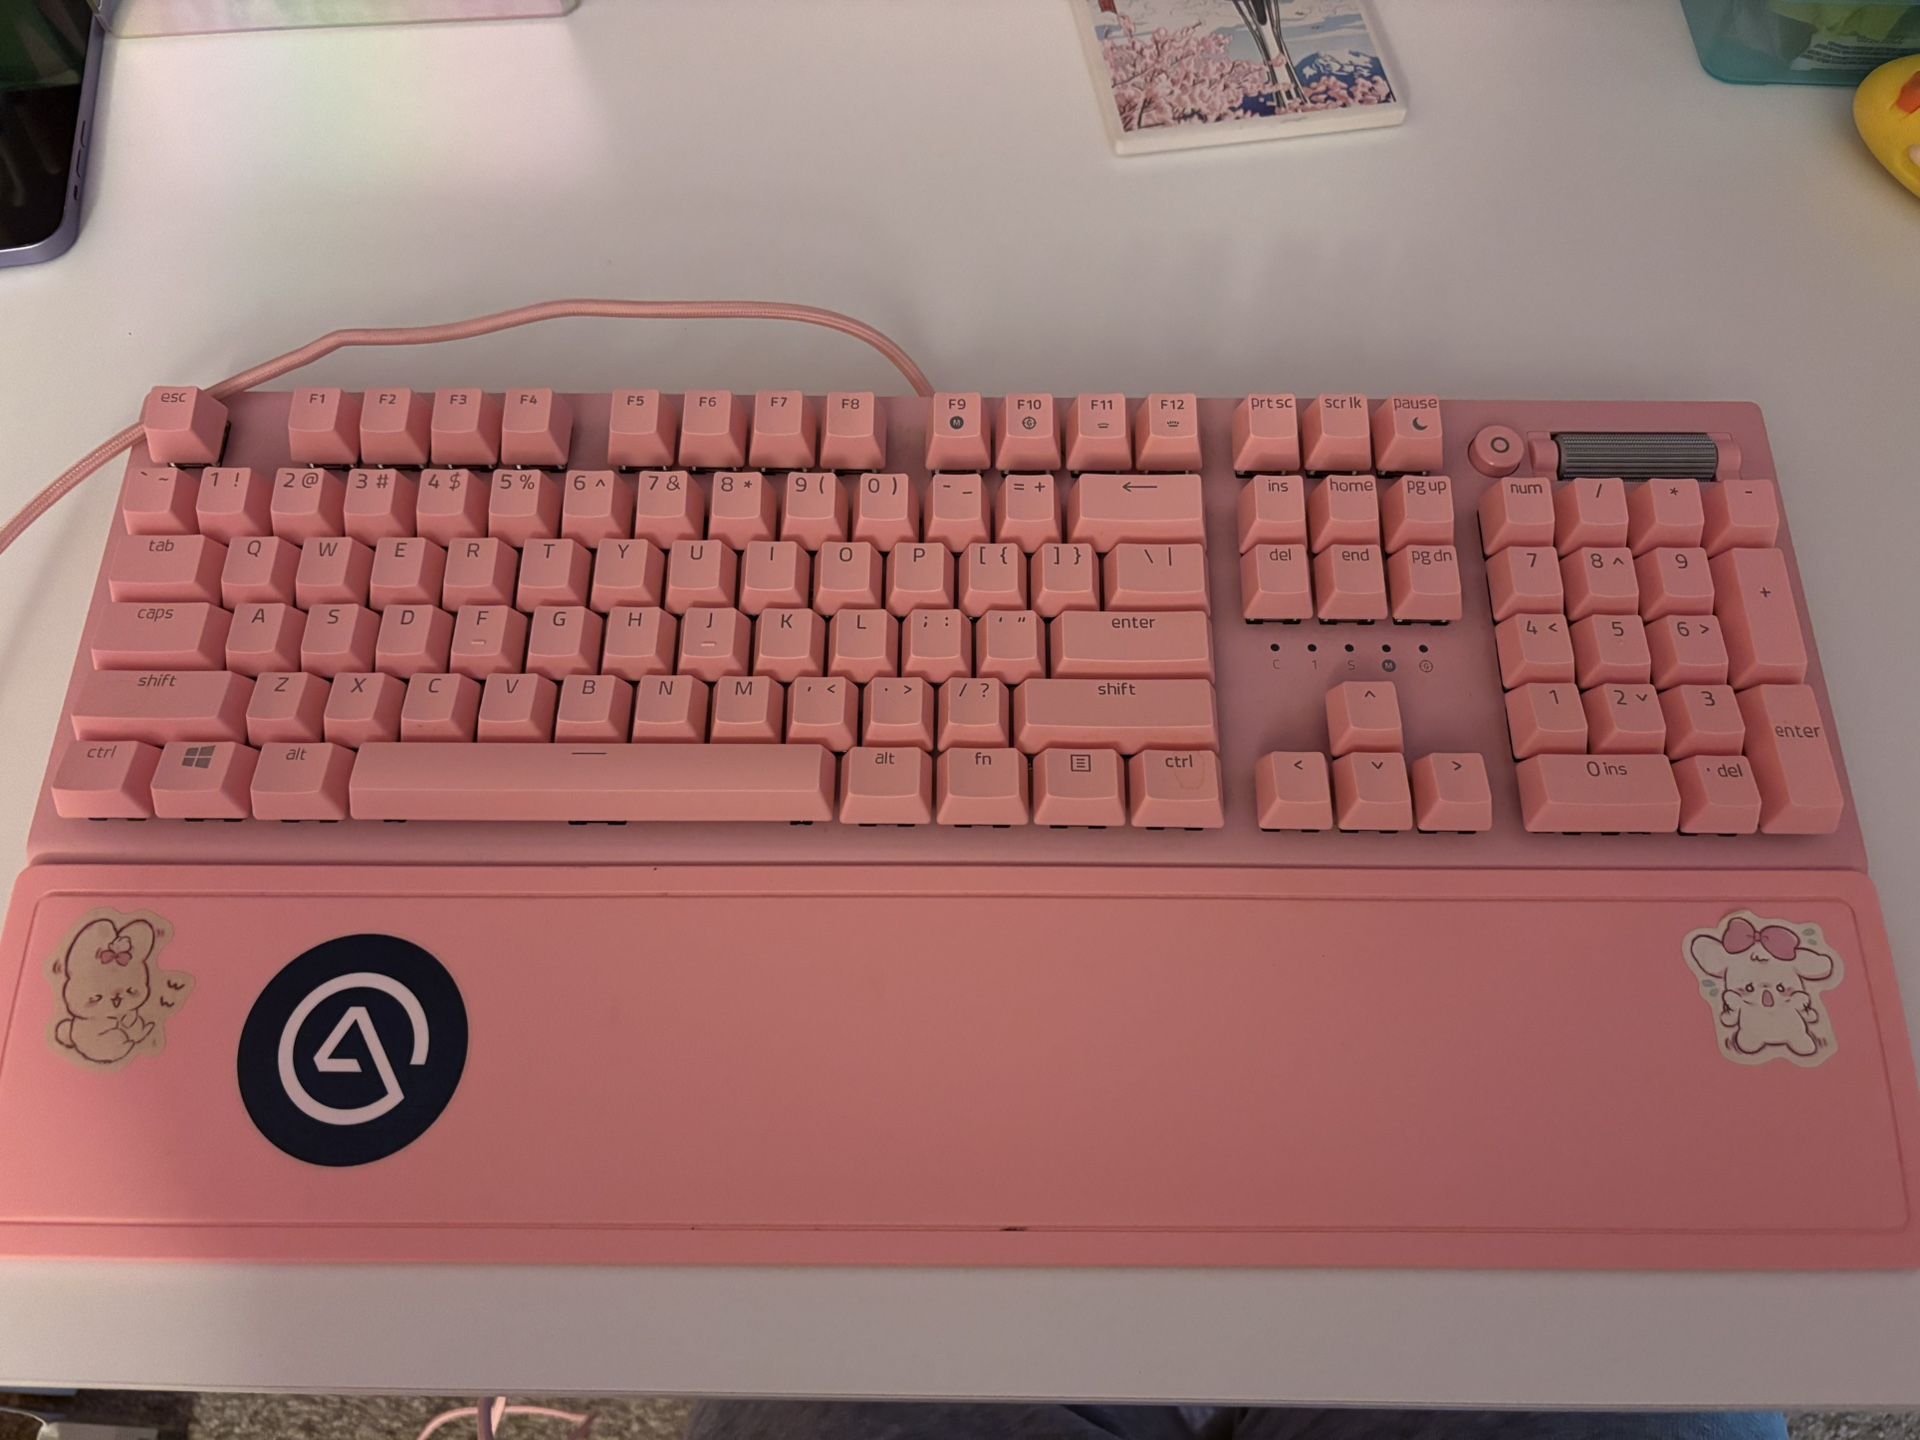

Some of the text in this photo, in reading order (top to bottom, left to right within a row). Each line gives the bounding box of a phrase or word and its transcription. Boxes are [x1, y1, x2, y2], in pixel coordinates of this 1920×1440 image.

[160, 392, 187, 403] esc
[309, 393, 326, 405] F1
[378, 393, 397, 405] F2
[449, 393, 468, 406] F3
[519, 394, 538, 405] F4
[626, 395, 645, 407] F5
[698, 396, 717, 408] F6
[770, 396, 788, 408] F7
[841, 398, 860, 410] F8
[948, 398, 967, 411] F9
[1017, 399, 1042, 411] F10
[1090, 399, 1113, 411] F11
[1160, 399, 1185, 410] F12
[1250, 397, 1293, 411] prt sc
[1324, 396, 1362, 409] scr lk
[1393, 398, 1438, 412] pause
[210, 471, 220, 488] 1
[282, 472, 296, 489] 2
[355, 472, 369, 490] 3
[427, 473, 440, 489] 4
[499, 473, 513, 490] 5
[573, 474, 587, 491] 6
[648, 475, 660, 491] 7
[720, 476, 734, 493] 8
[795, 476, 808, 493] 9
[867, 477, 880, 494] 0
[1267, 481, 1289, 493] ins
[1329, 477, 1374, 493] home
[1406, 479, 1447, 496] pg up
[1510, 483, 1543, 495] num
[148, 538, 175, 552] tab
[246, 539, 262, 558] Q
[318, 541, 339, 558] W
[394, 541, 408, 558] E
[466, 542, 480, 558] R
[543, 543, 556, 559] T
[617, 543, 630, 560] Y
[690, 544, 704, 561] U
[839, 546, 853, 563] O
[913, 547, 926, 563] P
[1269, 547, 1292, 562] del
[1341, 548, 1370, 562] end
[1411, 548, 1453, 566] pg dn
[1526, 552, 1538, 568] 7
[1590, 552, 1604, 569] 8
[1674, 553, 1688, 570] 9
[137, 607, 175, 623] caps
[251, 607, 265, 624] A
[327, 608, 341, 625] S
[400, 609, 415, 626] D
[476, 610, 489, 626] F
[552, 610, 567, 627] G
[627, 611, 643, 627] H
[706, 612, 713, 629] J
[780, 613, 793, 629] K
[856, 614, 867, 630] L
[1111, 616, 1156, 629] enter
[1524, 619, 1539, 636] 4
[1611, 621, 1625, 637] 5
[1676, 621, 1690, 638] 6
[1272, 658, 1281, 670] C
[1311, 659, 1318, 670] 1
[1346, 659, 1356, 671] S
[137, 673, 177, 688] shift
[273, 676, 290, 693] Z
[350, 677, 368, 693] X
[428, 677, 442, 694] C
[506, 678, 520, 694] V
[581, 679, 596, 695] B
[658, 680, 674, 696] N
[734, 680, 753, 696] M
[1097, 682, 1136, 696] shift
[1548, 689, 1559, 705] 1
[1613, 689, 1628, 706] 2
[1700, 690, 1716, 707] 3
[1774, 725, 1821, 739] enter
[86, 744, 118, 759] ctrl
[285, 746, 307, 761] alt
[874, 751, 896, 765] alt
[974, 751, 992, 766] fn
[1165, 753, 1193, 768] ctrl
[1586, 760, 1628, 777] 0 ins
[1716, 762, 1744, 778] del
